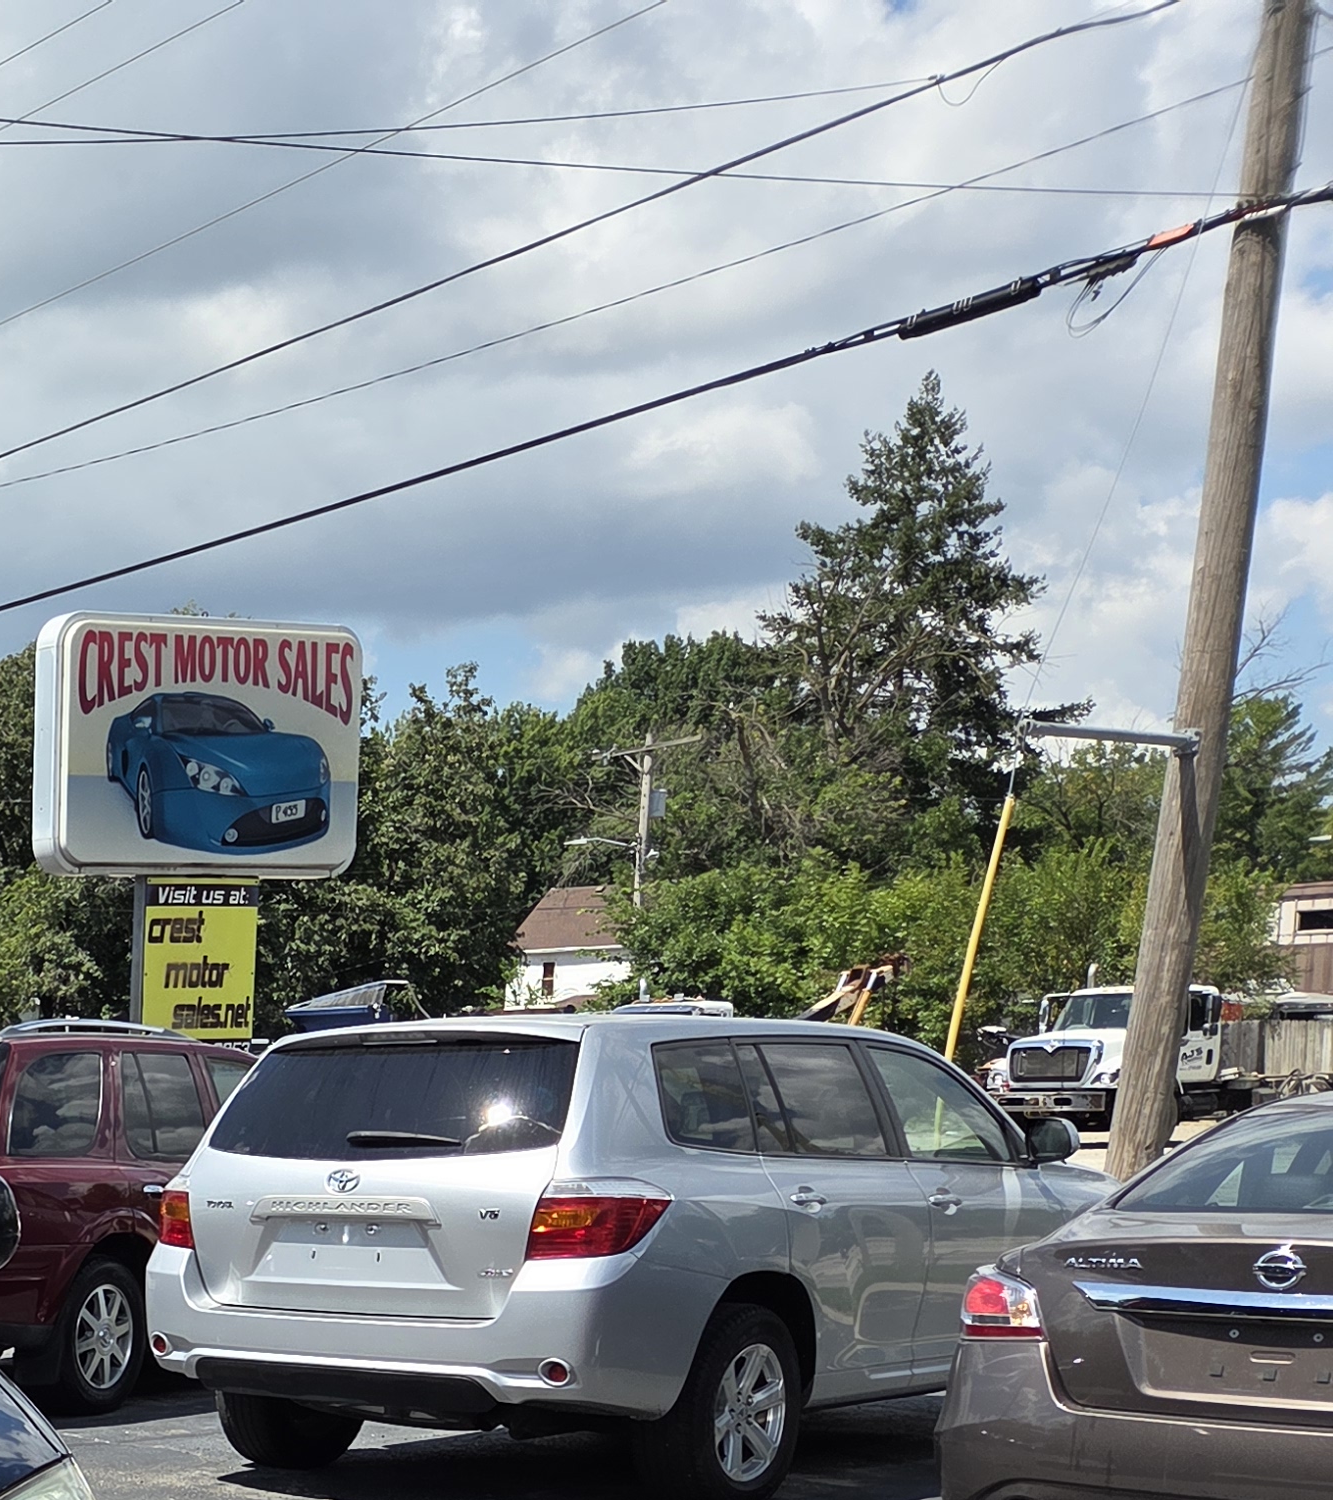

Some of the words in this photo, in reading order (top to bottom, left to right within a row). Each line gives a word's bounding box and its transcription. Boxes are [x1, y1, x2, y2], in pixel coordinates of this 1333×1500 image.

[78, 629, 167, 715] CREST
[174, 633, 270, 689] MOTOR
[277, 638, 354, 726] SALES
[158, 886, 197, 904] Visit
[201, 889, 226, 904] us
[229, 886, 250, 904] at:
[148, 910, 206, 944] crest
[164, 955, 231, 989] motor
[171, 995, 251, 1030] sales.net
[270, 1200, 413, 1214] HIGHLANDER
[478, 1207, 501, 1220] V6
[1063, 1256, 1145, 1270] ALTIMA
